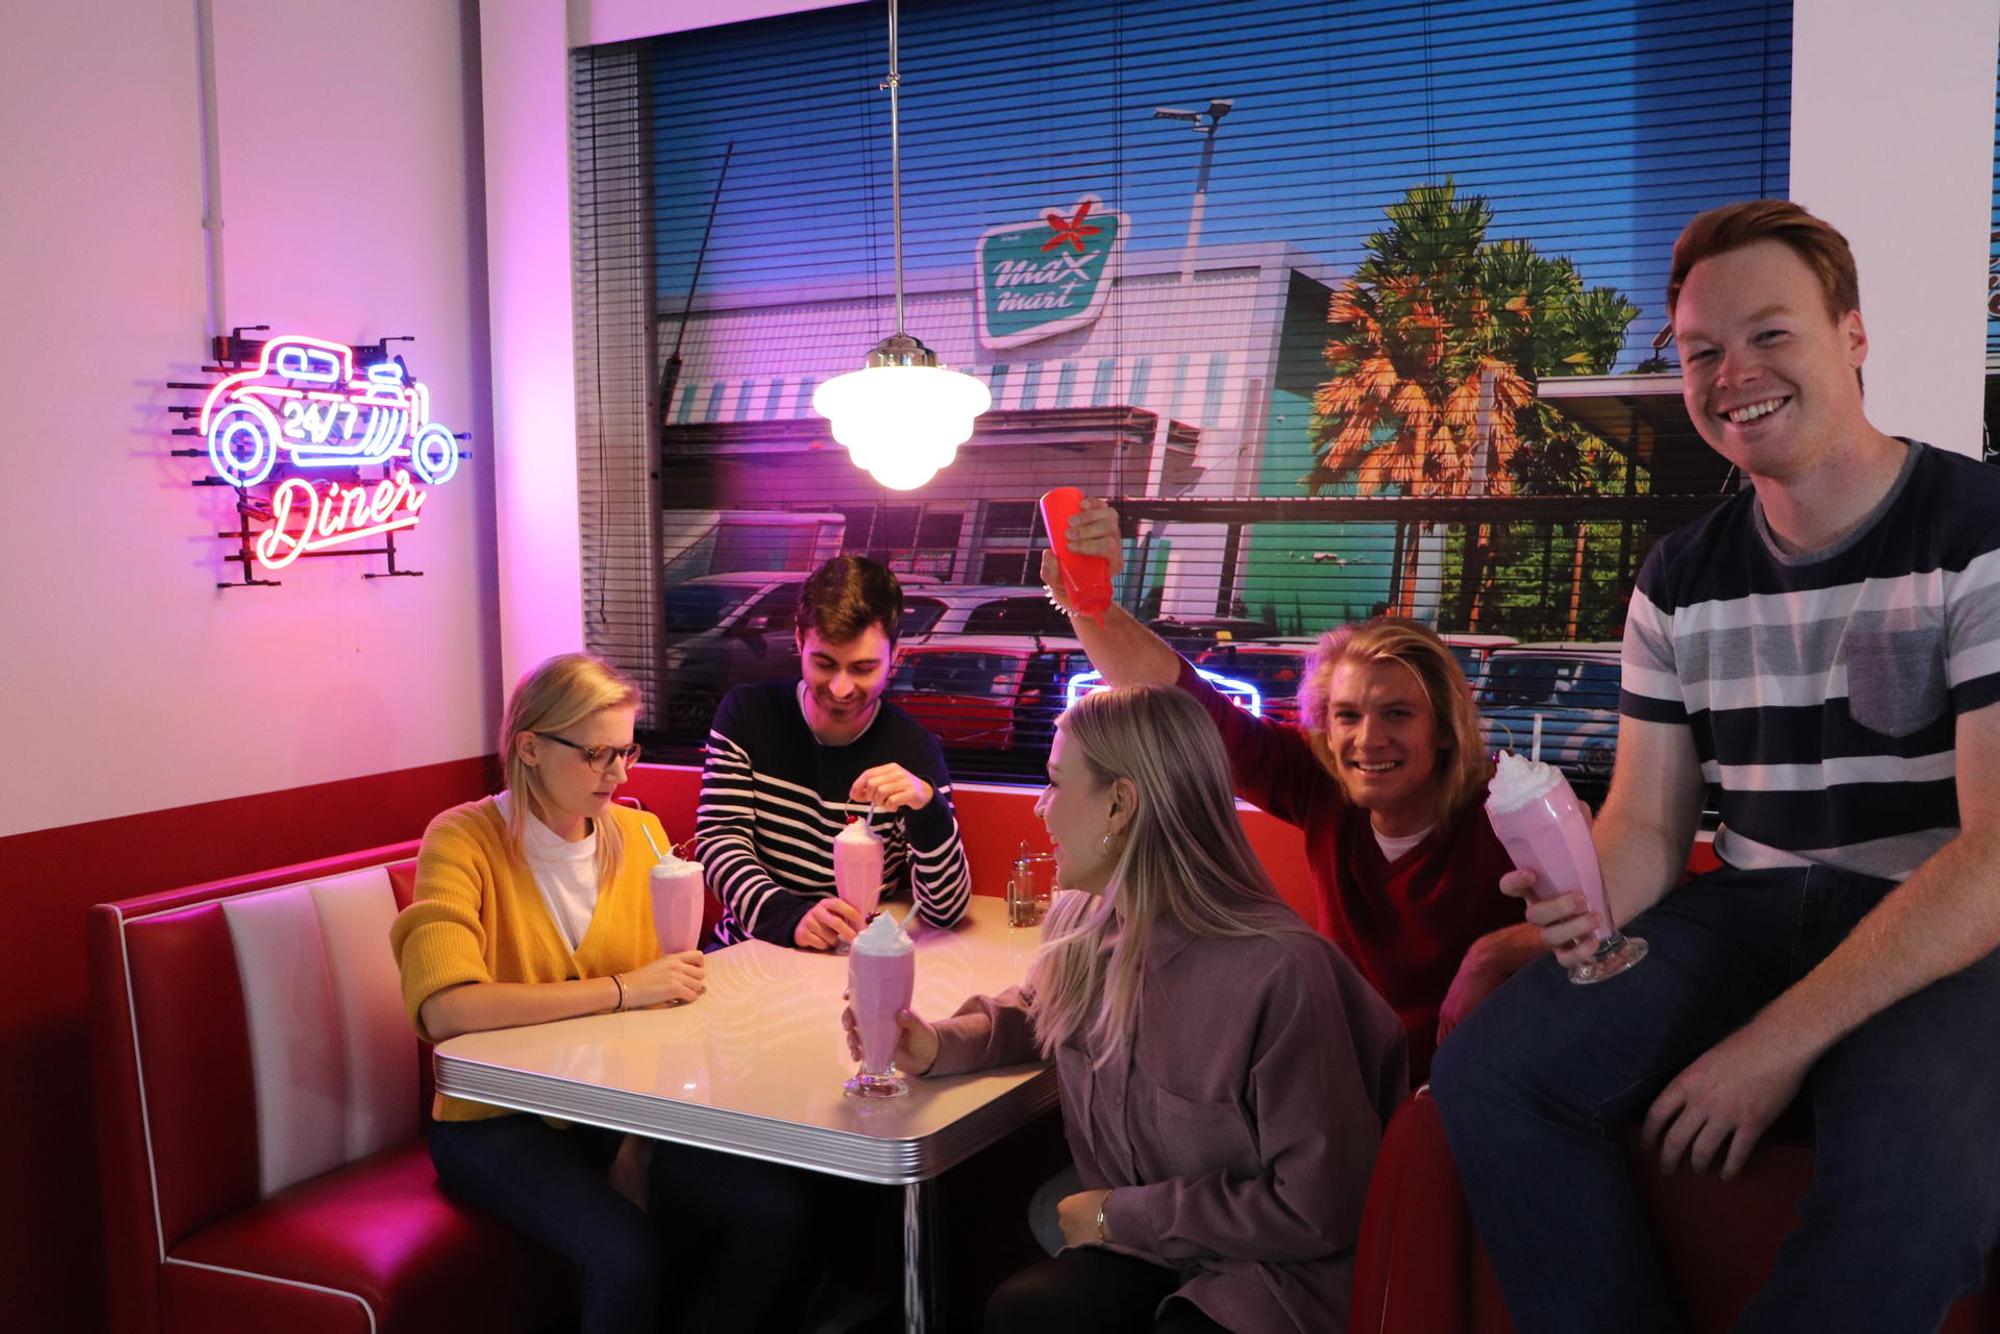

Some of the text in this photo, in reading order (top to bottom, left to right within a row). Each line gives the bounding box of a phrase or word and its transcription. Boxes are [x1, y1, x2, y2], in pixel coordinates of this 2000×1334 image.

[998, 278, 1084, 312] mart
[284, 401, 358, 443] 24/7
[257, 470, 426, 568] Diner
